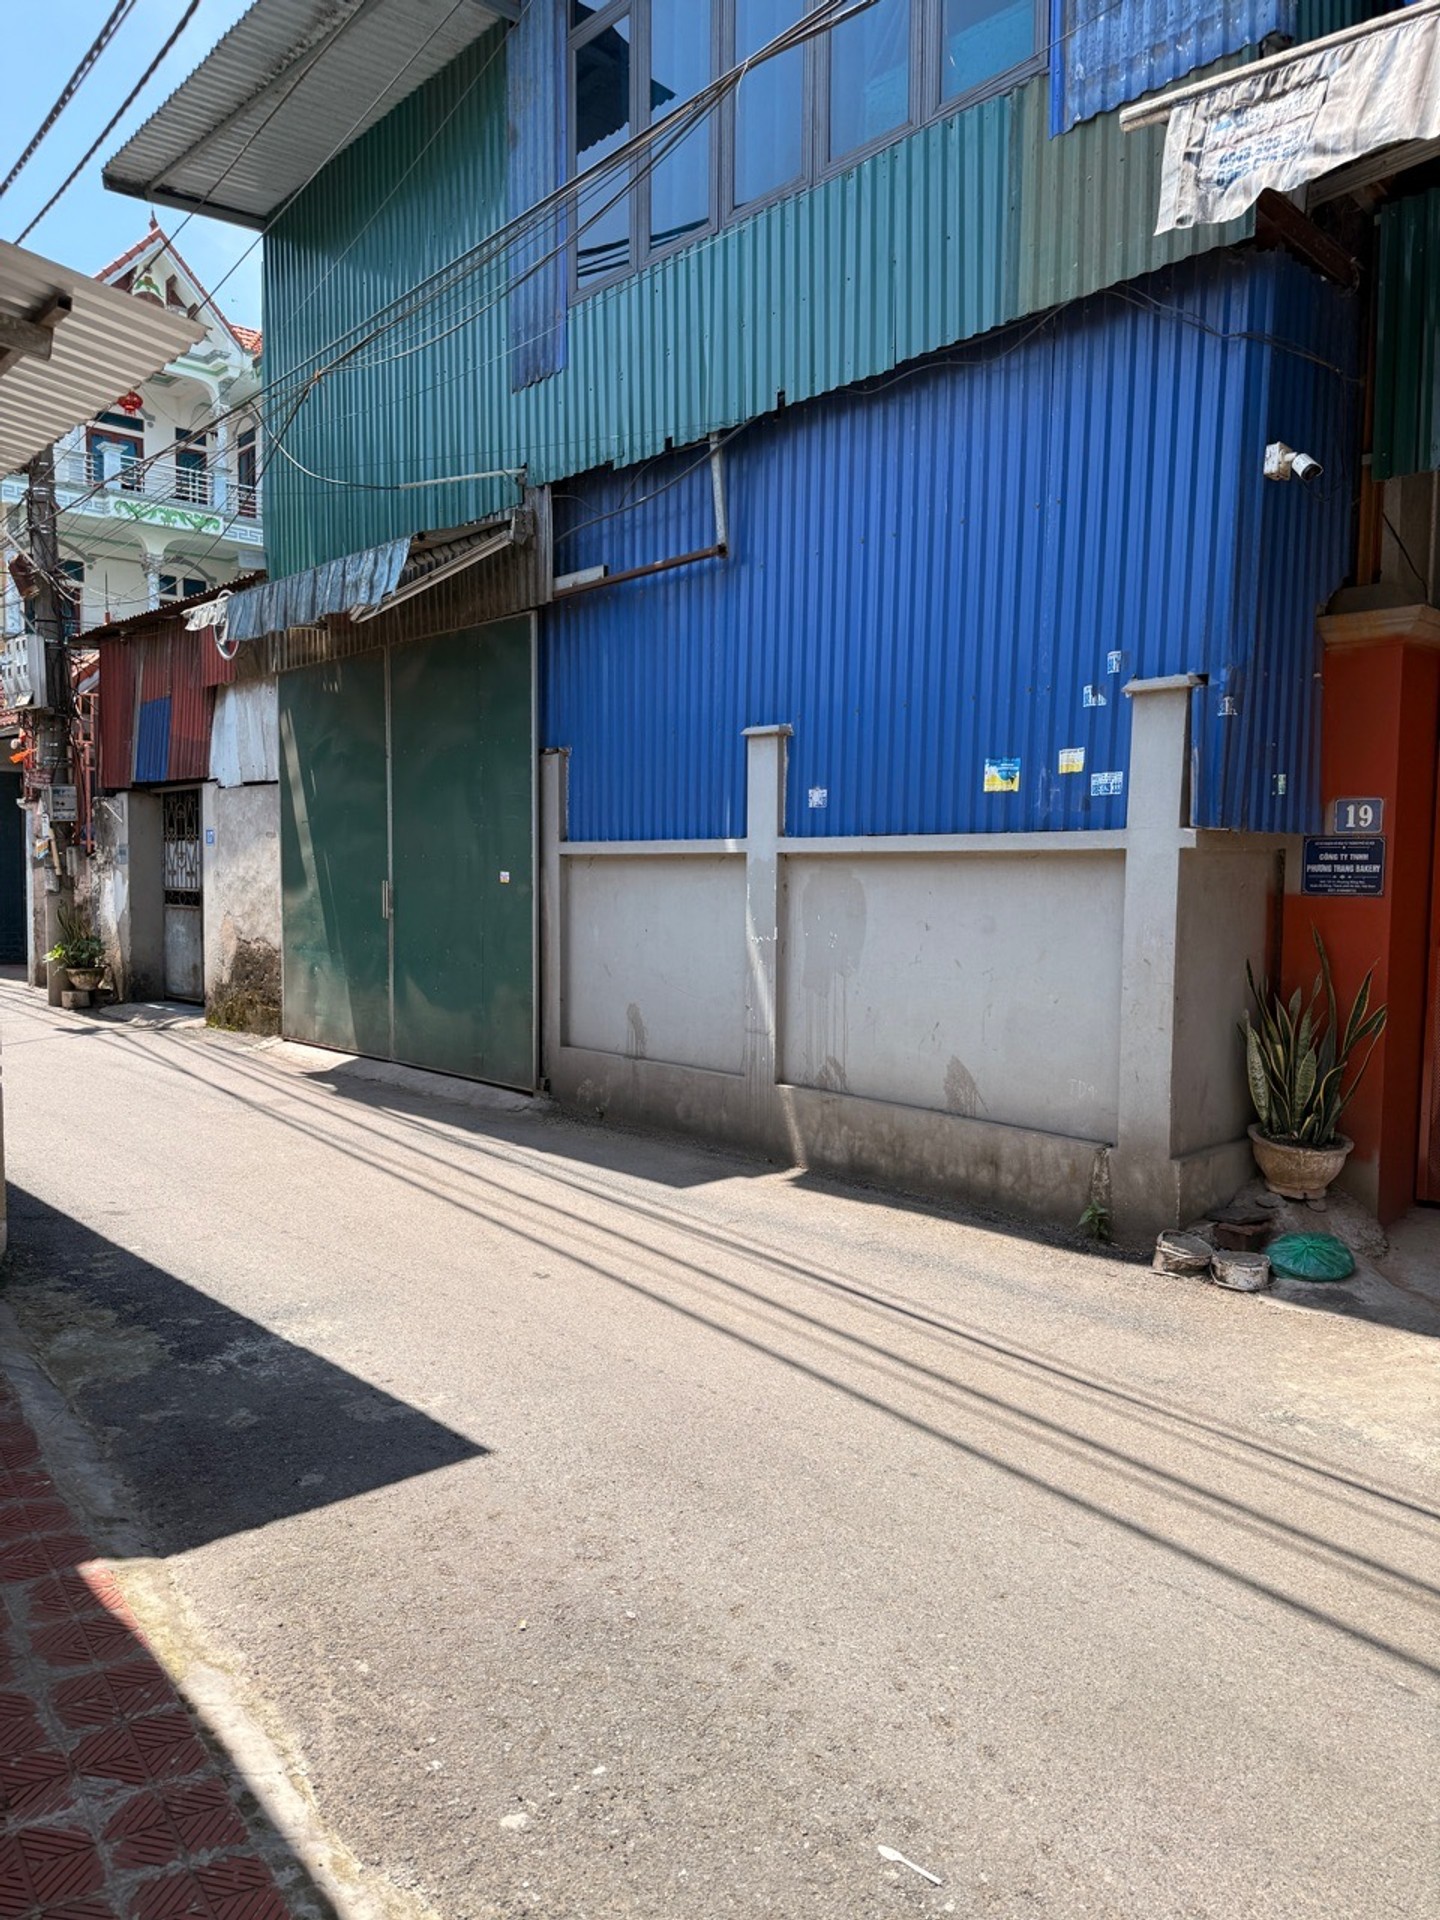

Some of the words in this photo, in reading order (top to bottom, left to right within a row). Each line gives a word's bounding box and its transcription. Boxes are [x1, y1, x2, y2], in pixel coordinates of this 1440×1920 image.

[1345, 804, 1374, 828] 19
[1318, 852, 1339, 861] CÔNG
[1340, 853, 1348, 861] TY
[1350, 853, 1369, 861] TNHH
[1333, 864, 1354, 873] TRANG
[1355, 864, 1381, 873] BAKERY
